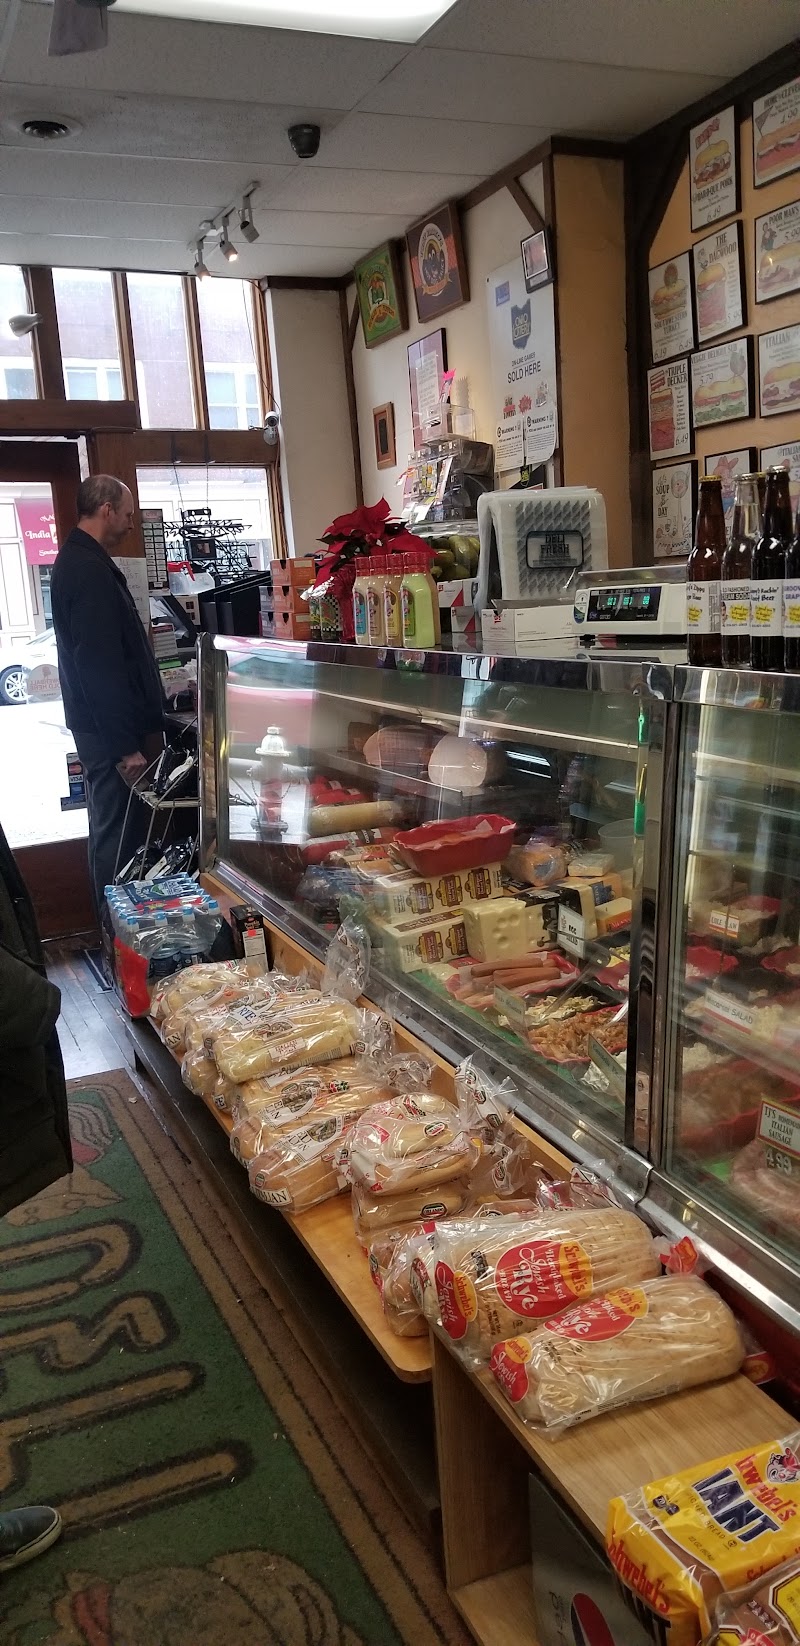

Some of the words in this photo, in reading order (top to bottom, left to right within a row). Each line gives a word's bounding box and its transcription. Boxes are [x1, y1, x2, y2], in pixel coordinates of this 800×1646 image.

[715, 232, 727, 246] THE
[507, 368, 525, 384] SOLD
[525, 360, 541, 377] HERE
[667, 363, 686, 377] TRIPLE
[666, 373, 688, 387] DECKER
[675, 433, 689, 446] 6.49
[655, 483, 670, 495] SOUP
[657, 506, 668, 517] DAY
[24, 529, 51, 540] India
[545, 533, 565, 543] DELI
[540, 544, 570, 556] FRESH
[238, 1006, 257, 1021] RYE
[731, 1009, 753, 1025] SALAD
[771, 1120, 793, 1136] ITALIAN
[768, 1129, 792, 1146] SAUSAGE
[510, 1260, 539, 1311] Rye
[437, 1266, 459, 1322] Jewish
[456, 1275, 473, 1317] Schwebel's
[493, 1350, 517, 1384] Jewish
[691, 1467, 782, 1543] IANT
